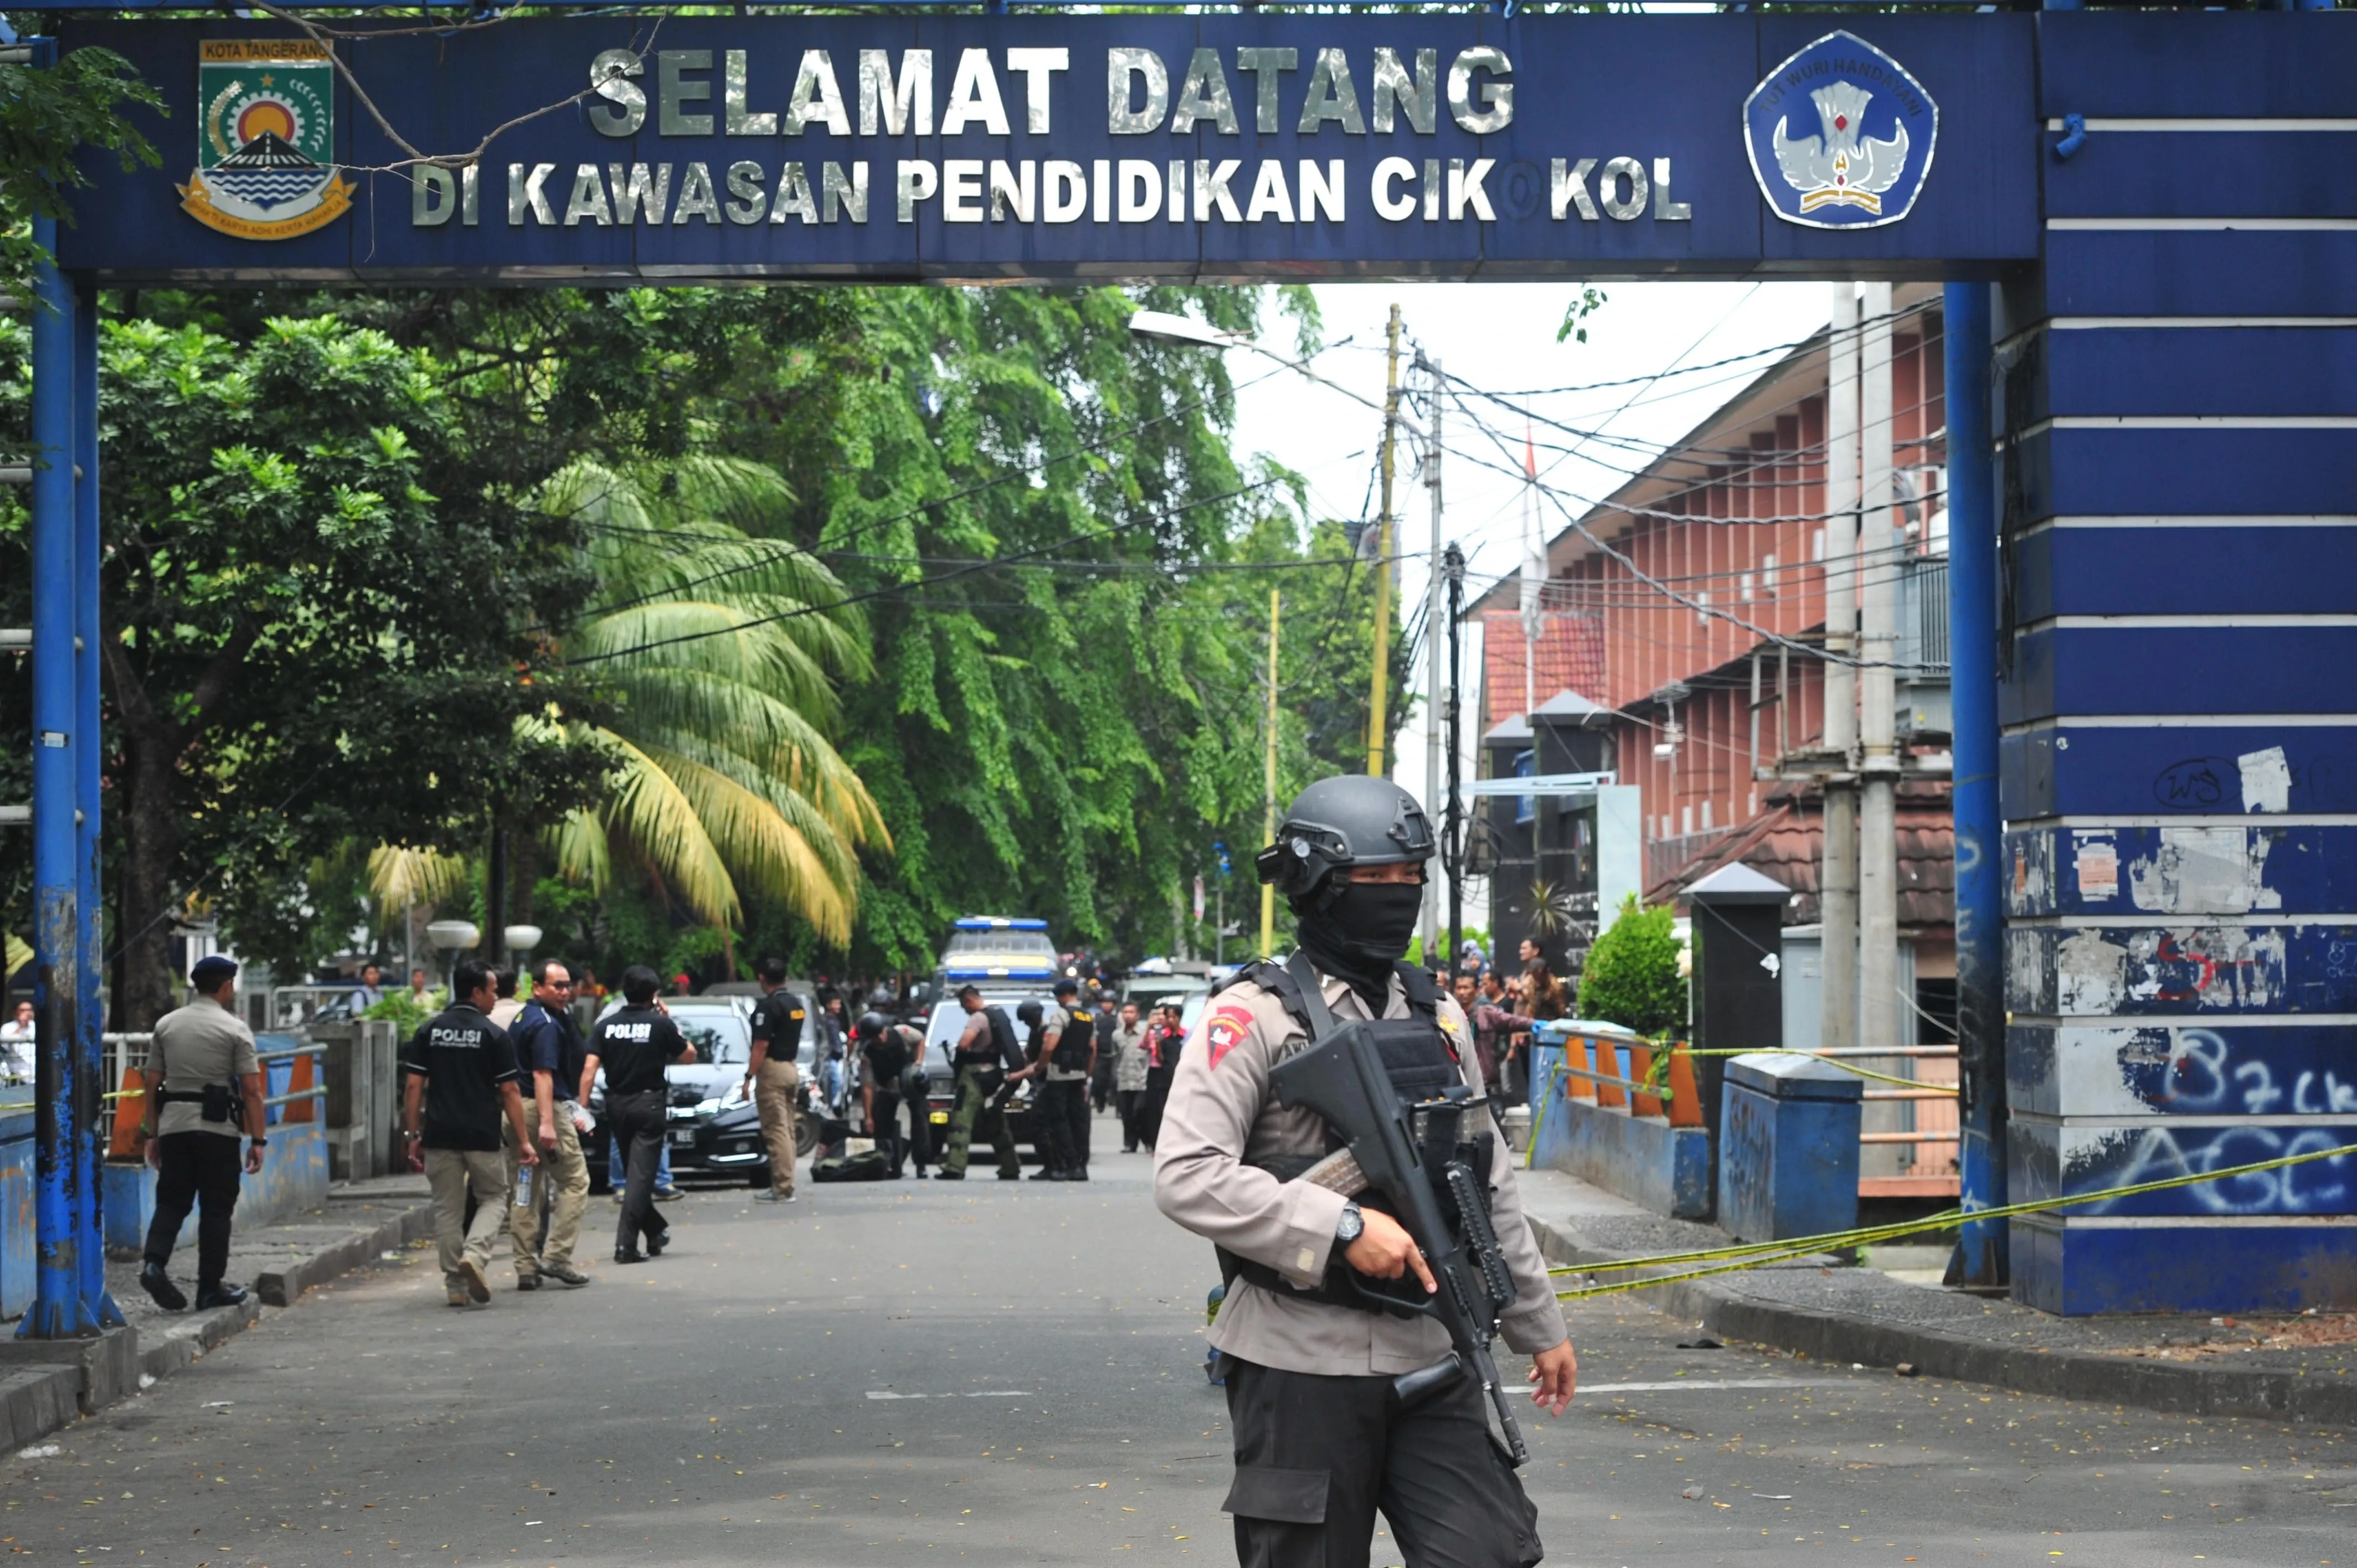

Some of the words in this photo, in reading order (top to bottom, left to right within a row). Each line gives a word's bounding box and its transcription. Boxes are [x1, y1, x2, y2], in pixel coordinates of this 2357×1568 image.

[205, 44, 243, 58] KOTA
[588, 47, 1069, 137] SELAMAT
[1108, 45, 1514, 135] DATANG
[1761, 82, 1786, 112] TUT
[1786, 60, 1828, 86] WURI
[1833, 58, 1923, 117] HANDAYANI
[412, 162, 479, 226] DI
[508, 160, 869, 225] KAWASAN
[897, 159, 1345, 223] PENDIDIKAN
[431, 1028, 482, 1043] POLISI
